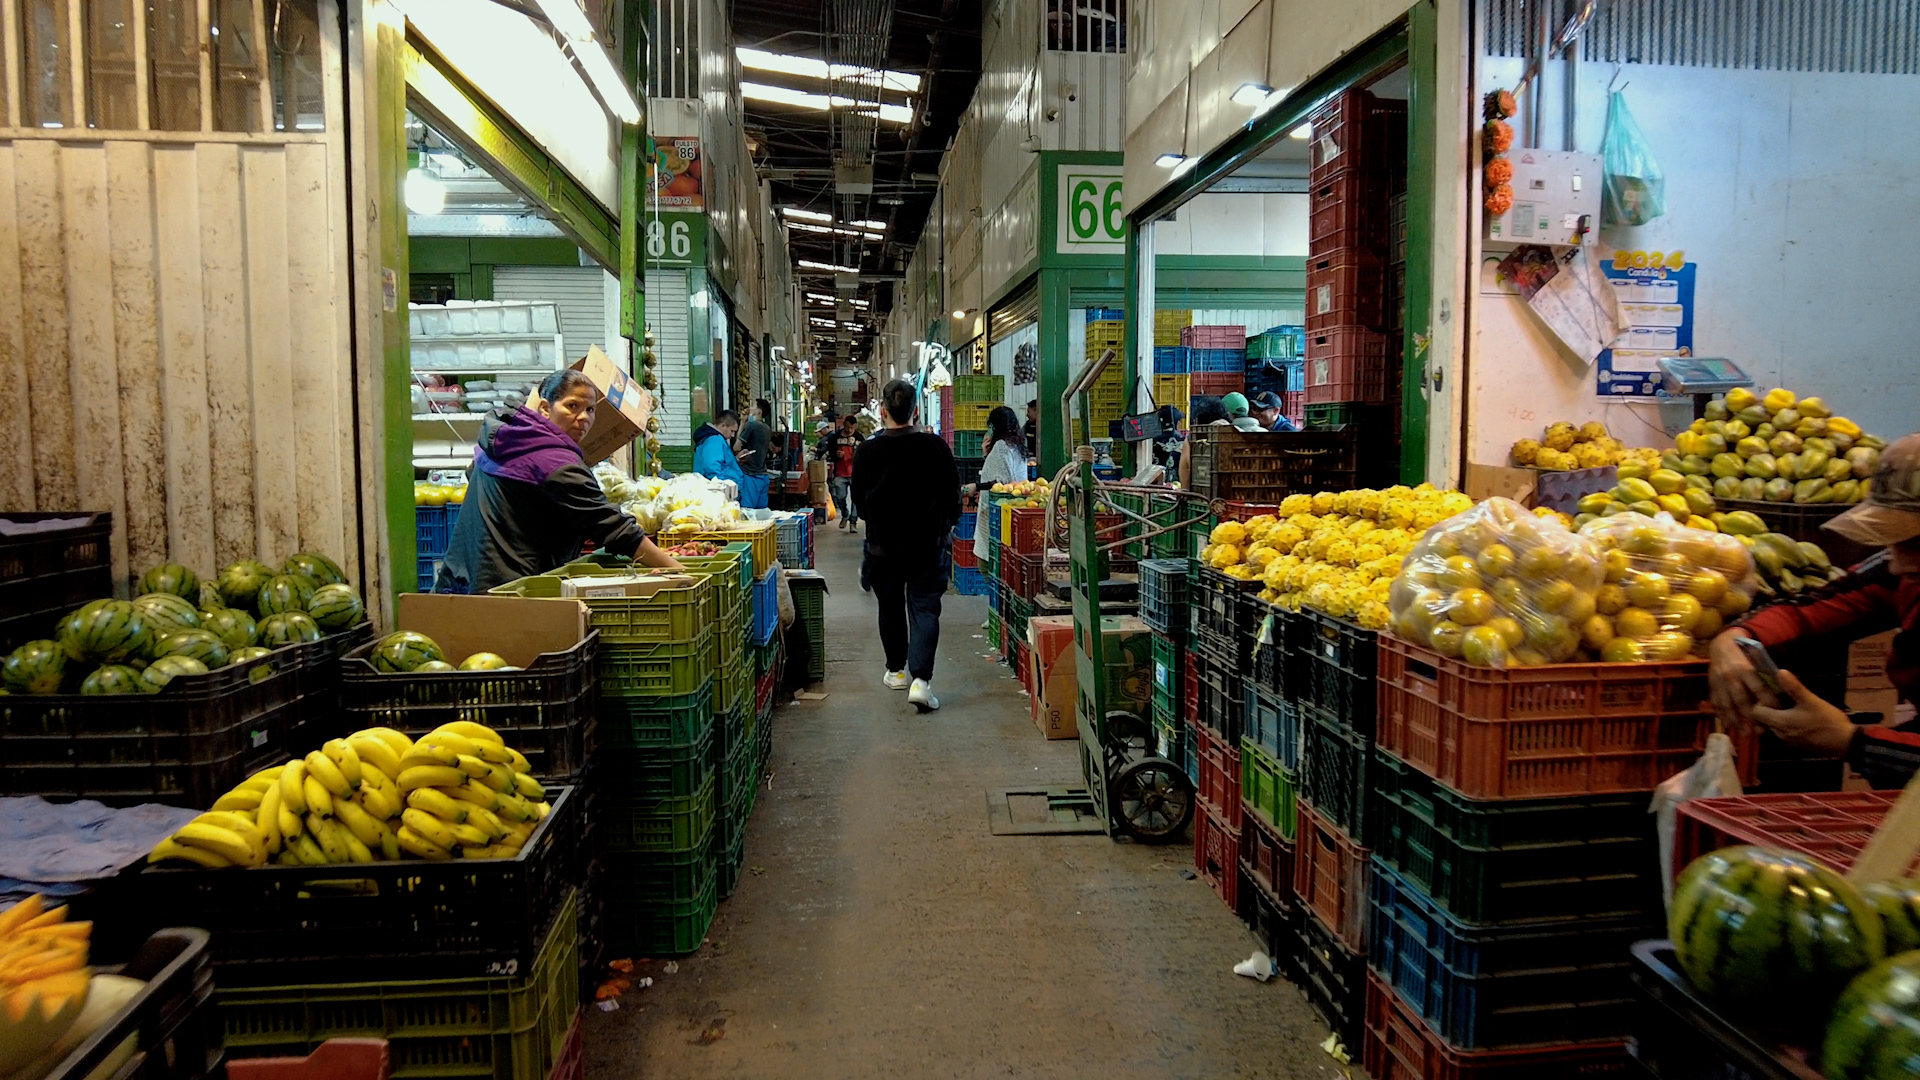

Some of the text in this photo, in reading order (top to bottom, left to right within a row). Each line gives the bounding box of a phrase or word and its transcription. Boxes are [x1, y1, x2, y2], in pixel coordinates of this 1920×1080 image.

[680, 148, 694, 158] 86
[1071, 180, 1126, 239] 66
[647, 220, 691, 258] 86
[1613, 249, 1685, 271] 2024
[1051, 710, 1061, 730] P50
